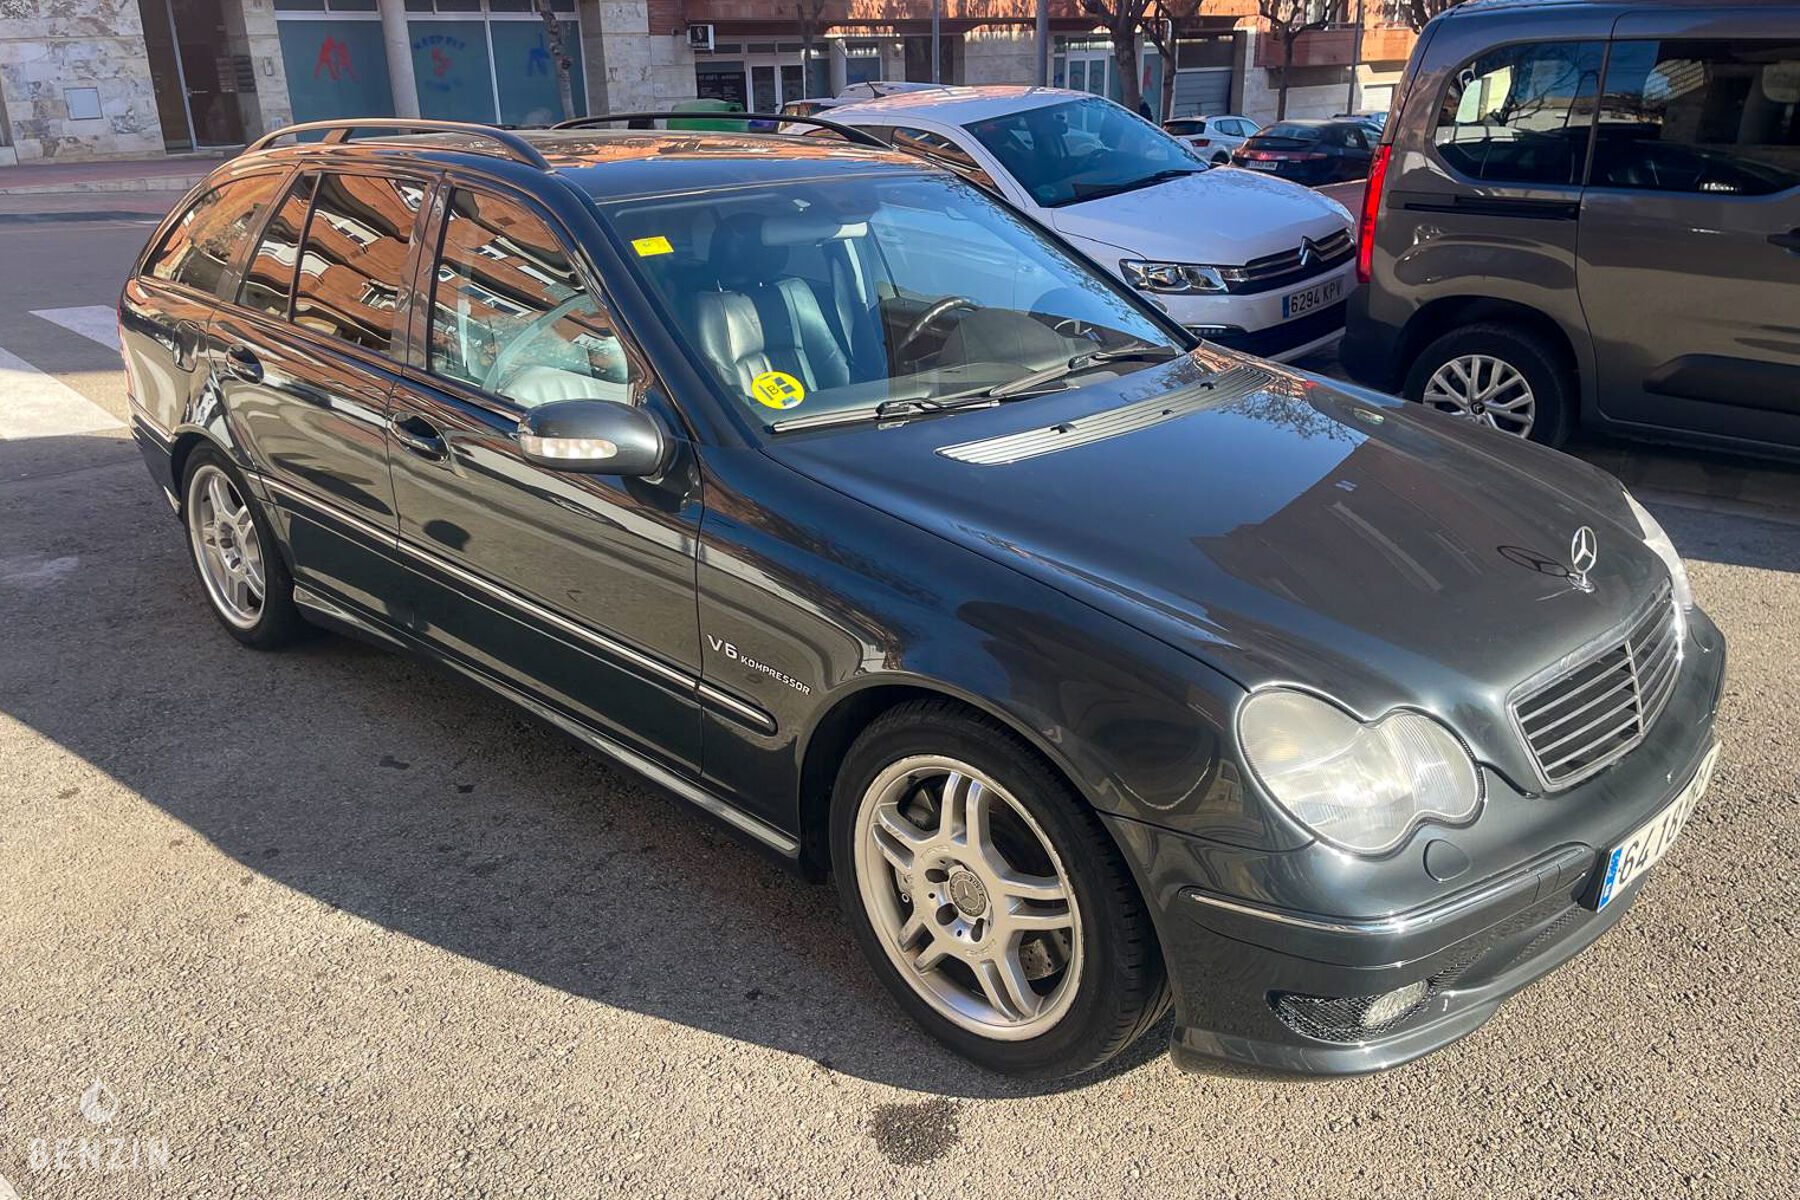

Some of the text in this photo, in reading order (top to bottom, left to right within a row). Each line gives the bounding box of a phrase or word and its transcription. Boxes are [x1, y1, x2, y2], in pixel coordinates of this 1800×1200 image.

[1290, 289, 1320, 313] 6294
[707, 634, 812, 696] V6 KOMPRESSOR
